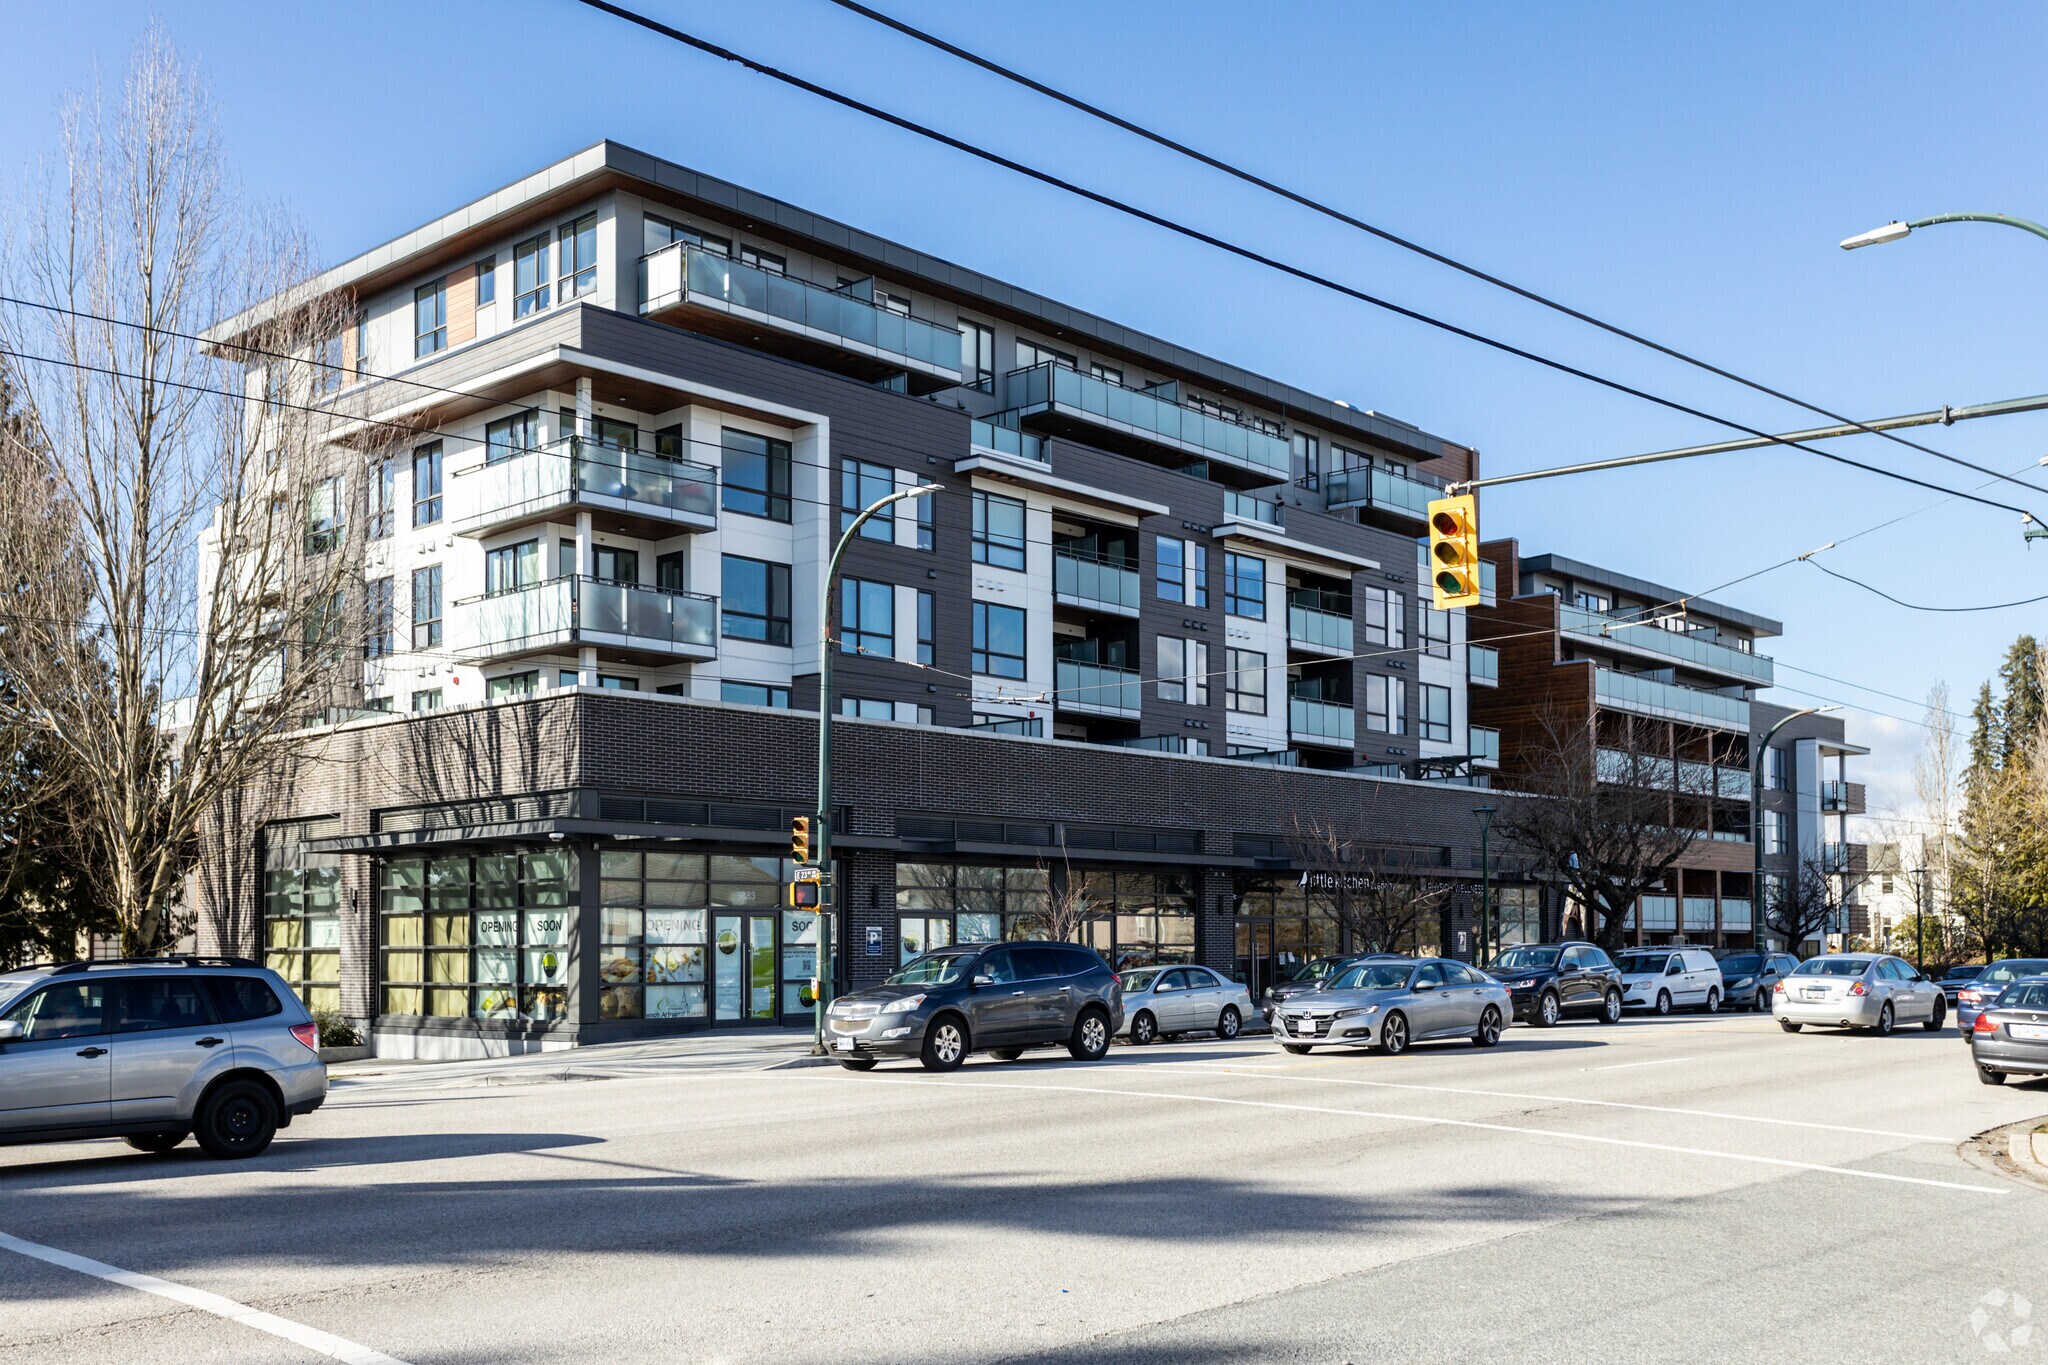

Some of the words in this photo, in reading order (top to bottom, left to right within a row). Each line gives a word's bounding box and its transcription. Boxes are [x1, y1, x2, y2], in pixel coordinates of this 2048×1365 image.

[537, 920, 562, 932] SOON
[791, 920, 816, 932] SOO
[870, 931, 878, 944] P
